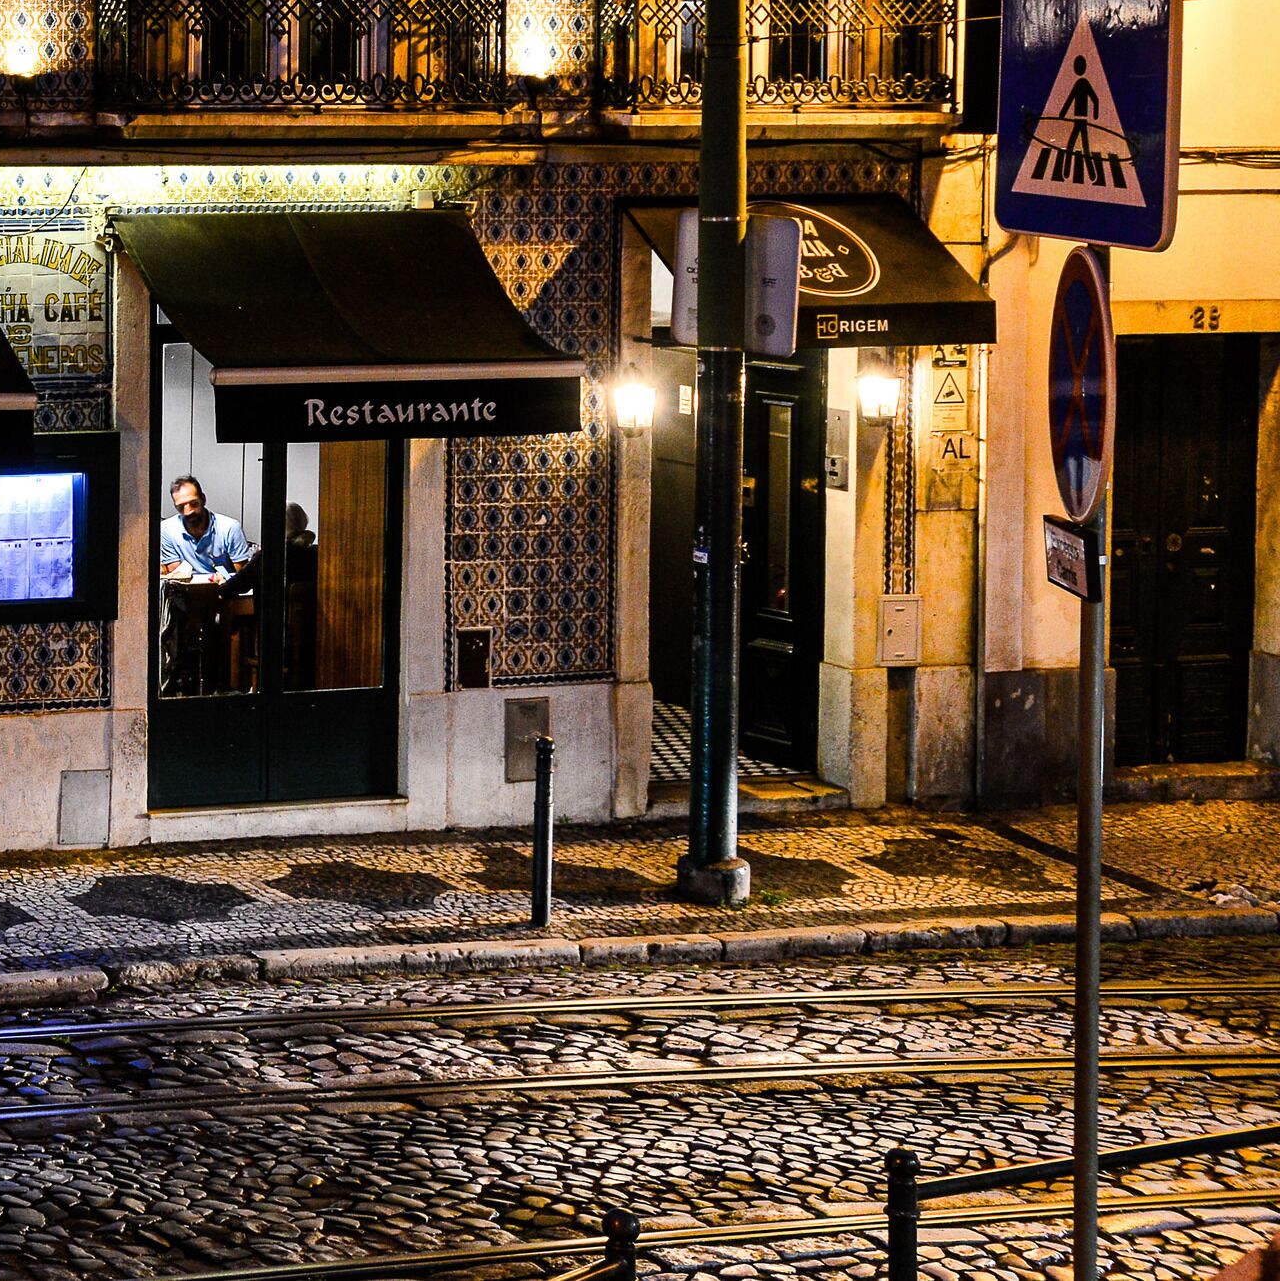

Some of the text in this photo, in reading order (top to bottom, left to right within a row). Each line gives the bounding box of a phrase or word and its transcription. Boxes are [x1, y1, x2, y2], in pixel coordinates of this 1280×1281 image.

[45, 289, 104, 322] CAFÉ
[817, 315, 889, 338] HORIGEM
[14, 344, 104, 374] ENEROS
[304, 398, 496, 427] Restaurante
[942, 438, 971, 459] AL
